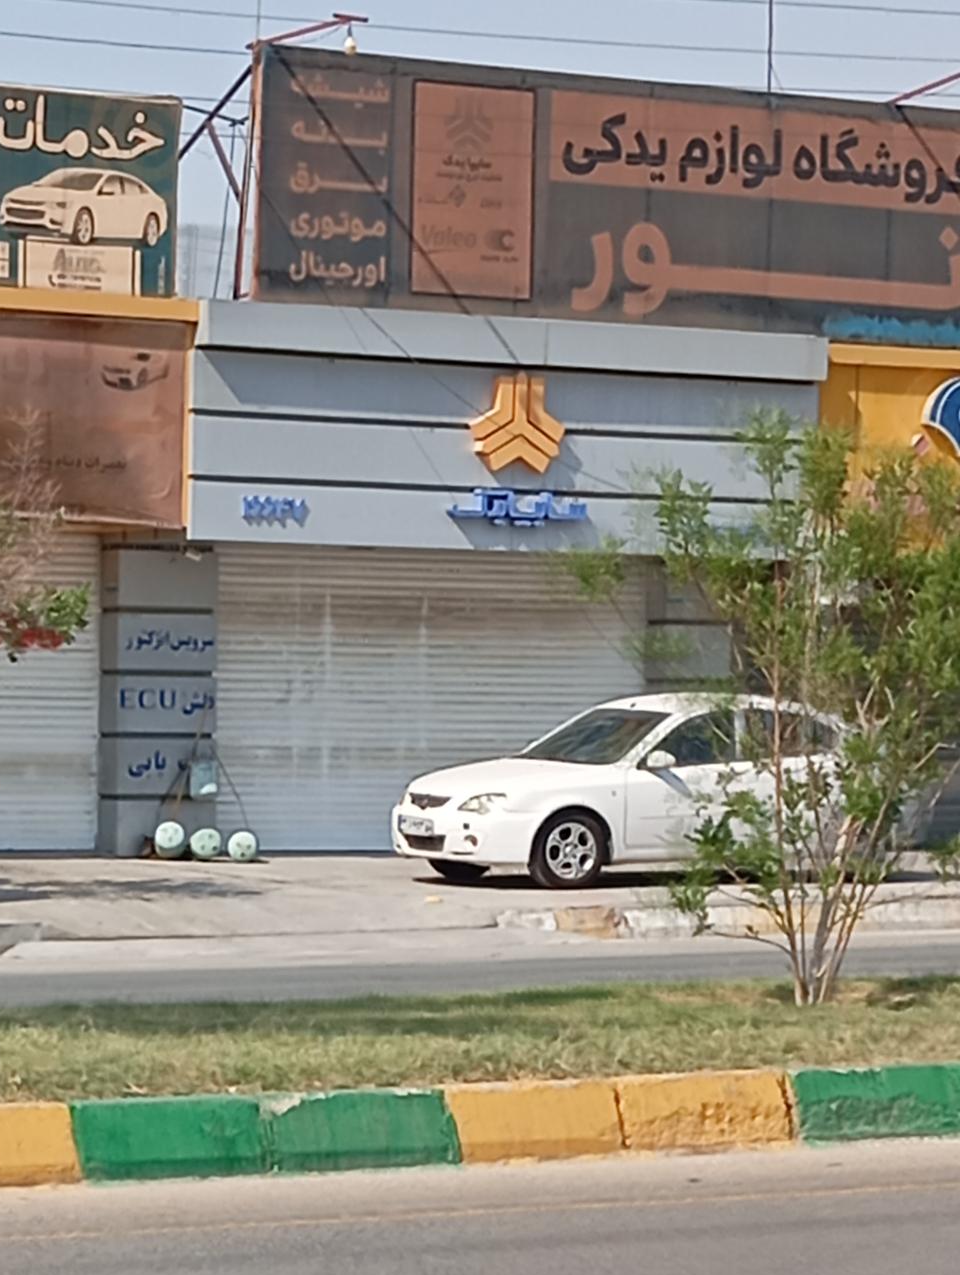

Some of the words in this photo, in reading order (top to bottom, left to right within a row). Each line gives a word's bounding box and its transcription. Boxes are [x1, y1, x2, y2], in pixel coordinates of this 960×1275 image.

[562, 113, 667, 184] یدکی
[678, 126, 782, 189] لوازم
[793, 128, 960, 204] روشگاه
[290, 210, 386, 243] موتوری
[120, 688, 177, 710] ECU
